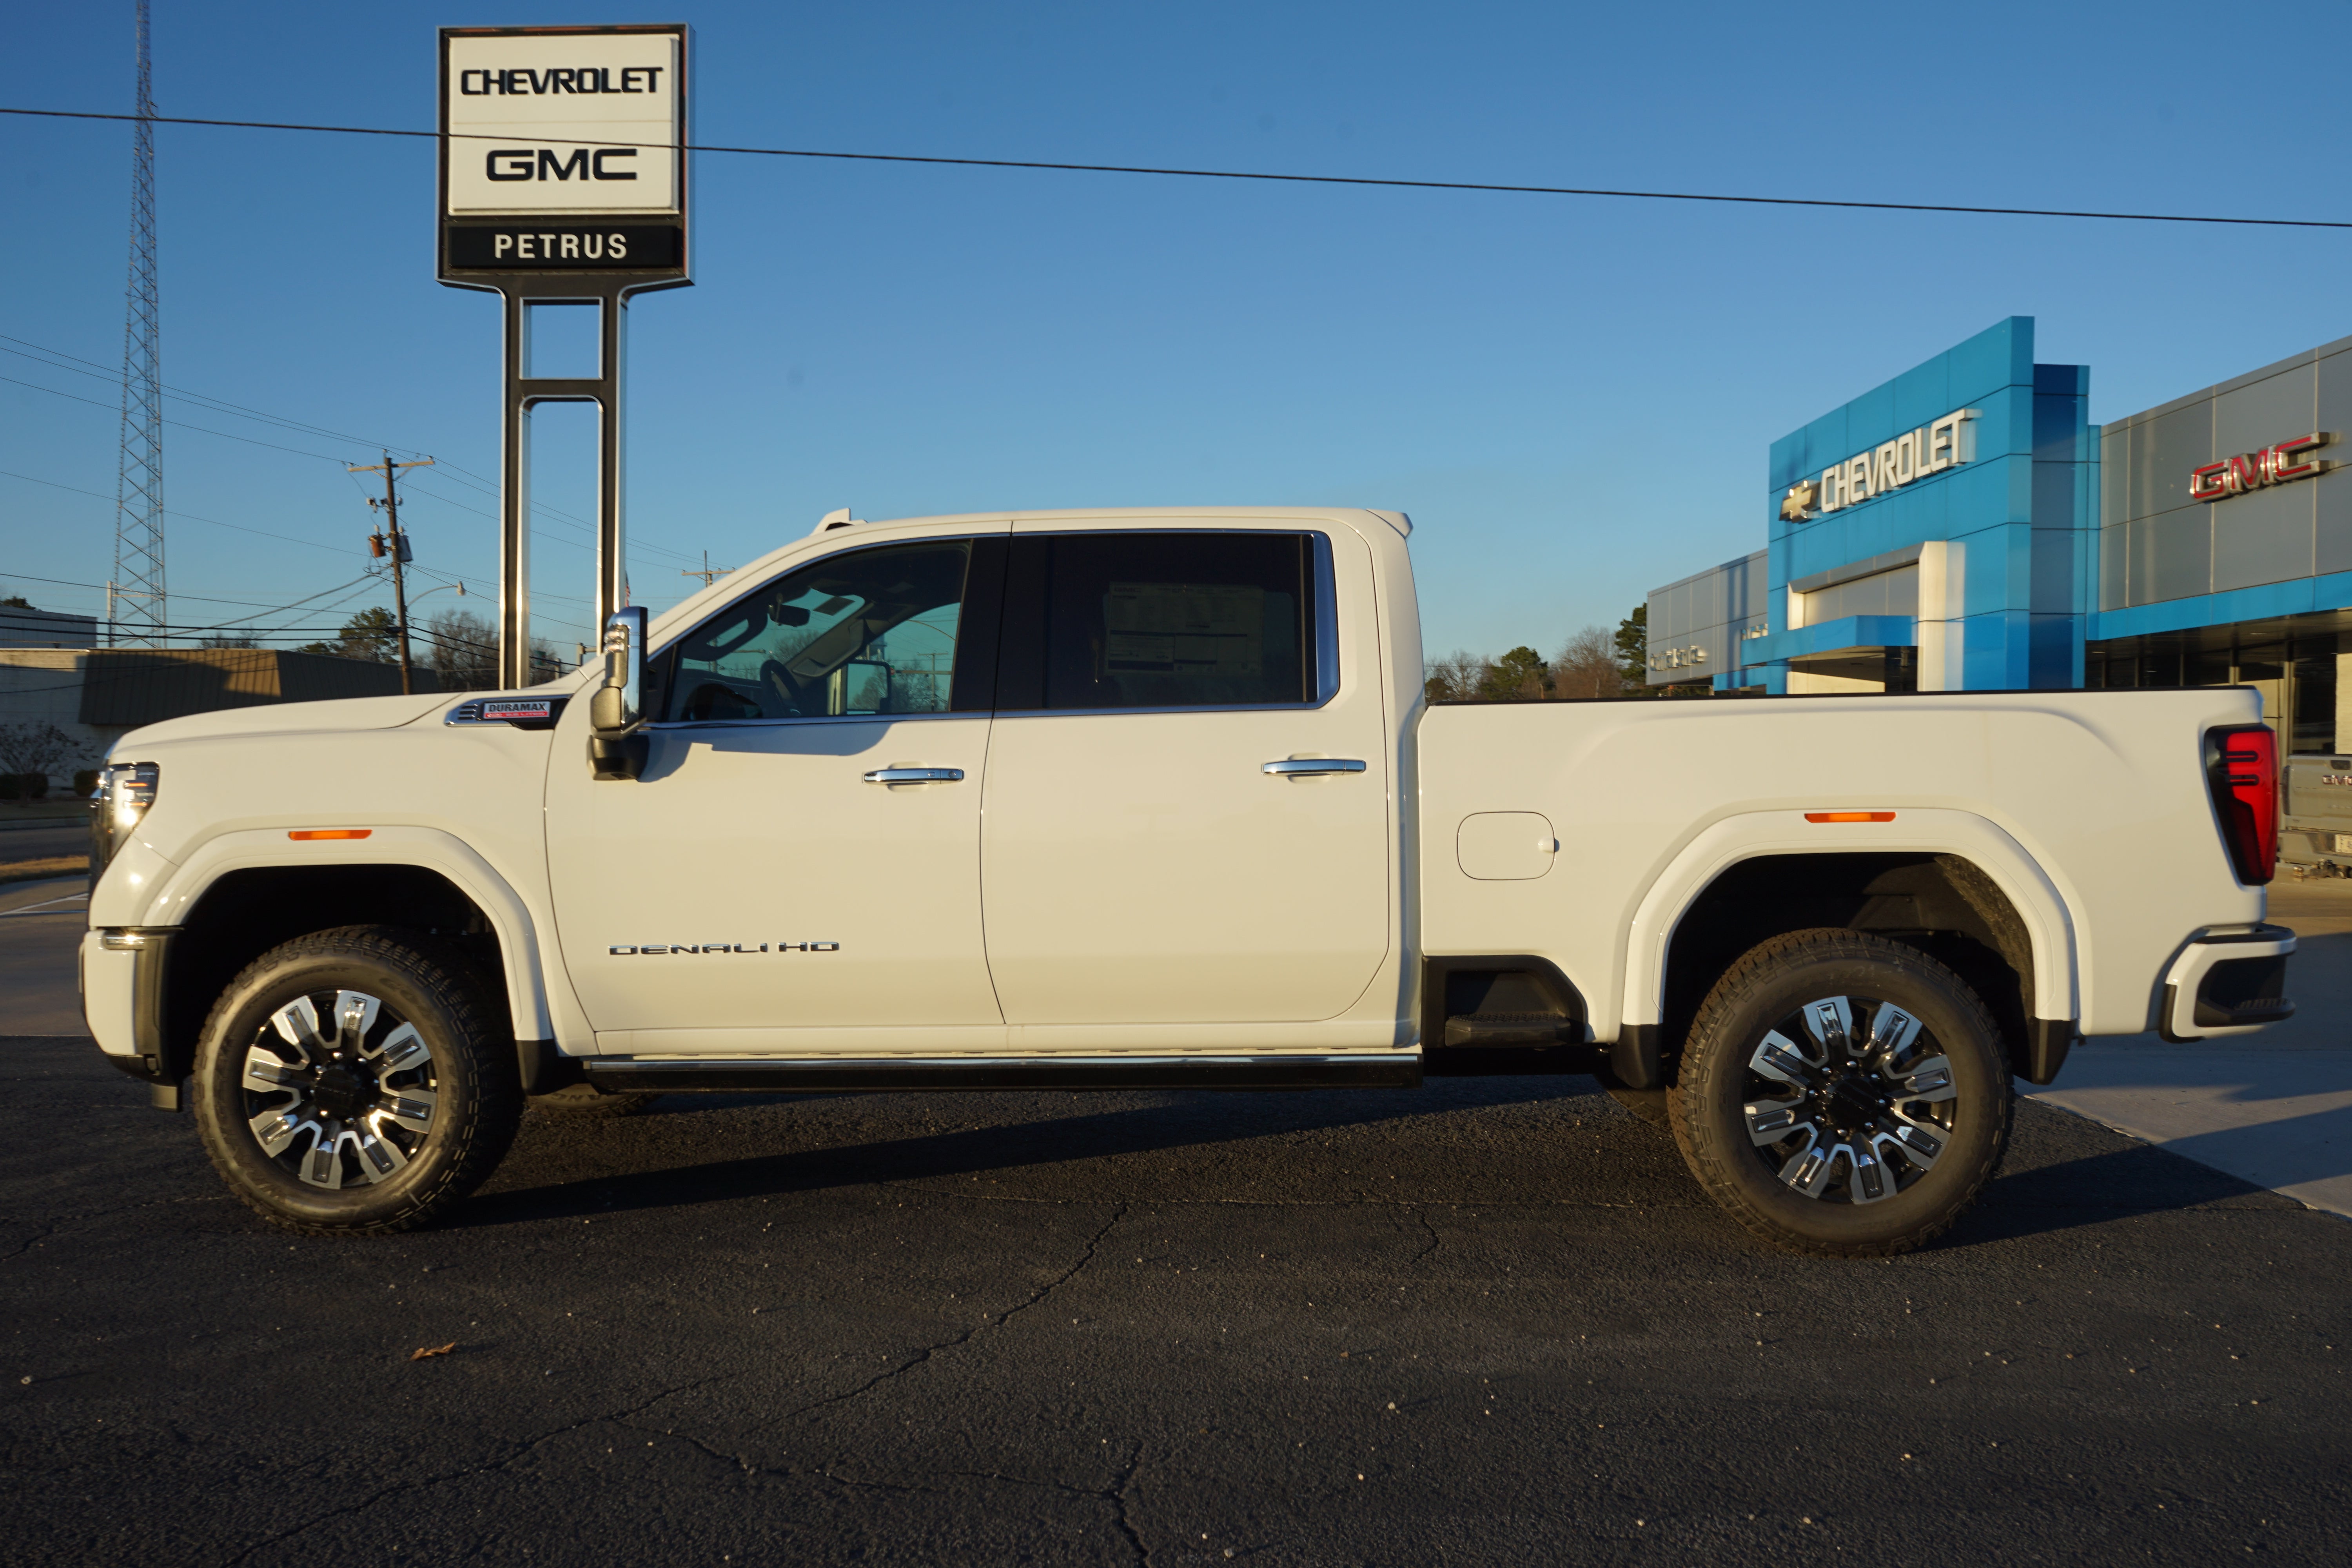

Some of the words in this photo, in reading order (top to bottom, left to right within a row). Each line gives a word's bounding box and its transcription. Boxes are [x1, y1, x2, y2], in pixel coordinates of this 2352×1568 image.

[461, 67, 664, 95] CHEVROLET
[486, 148, 637, 181] GMC
[494, 233, 627, 259] PETRUS
[1820, 408, 1982, 513] CHEVROLET
[2189, 432, 2330, 502] GMC
[489, 702, 546, 711] DURAMAX
[608, 942, 768, 955] DENALI
[777, 941, 840, 952] HD
